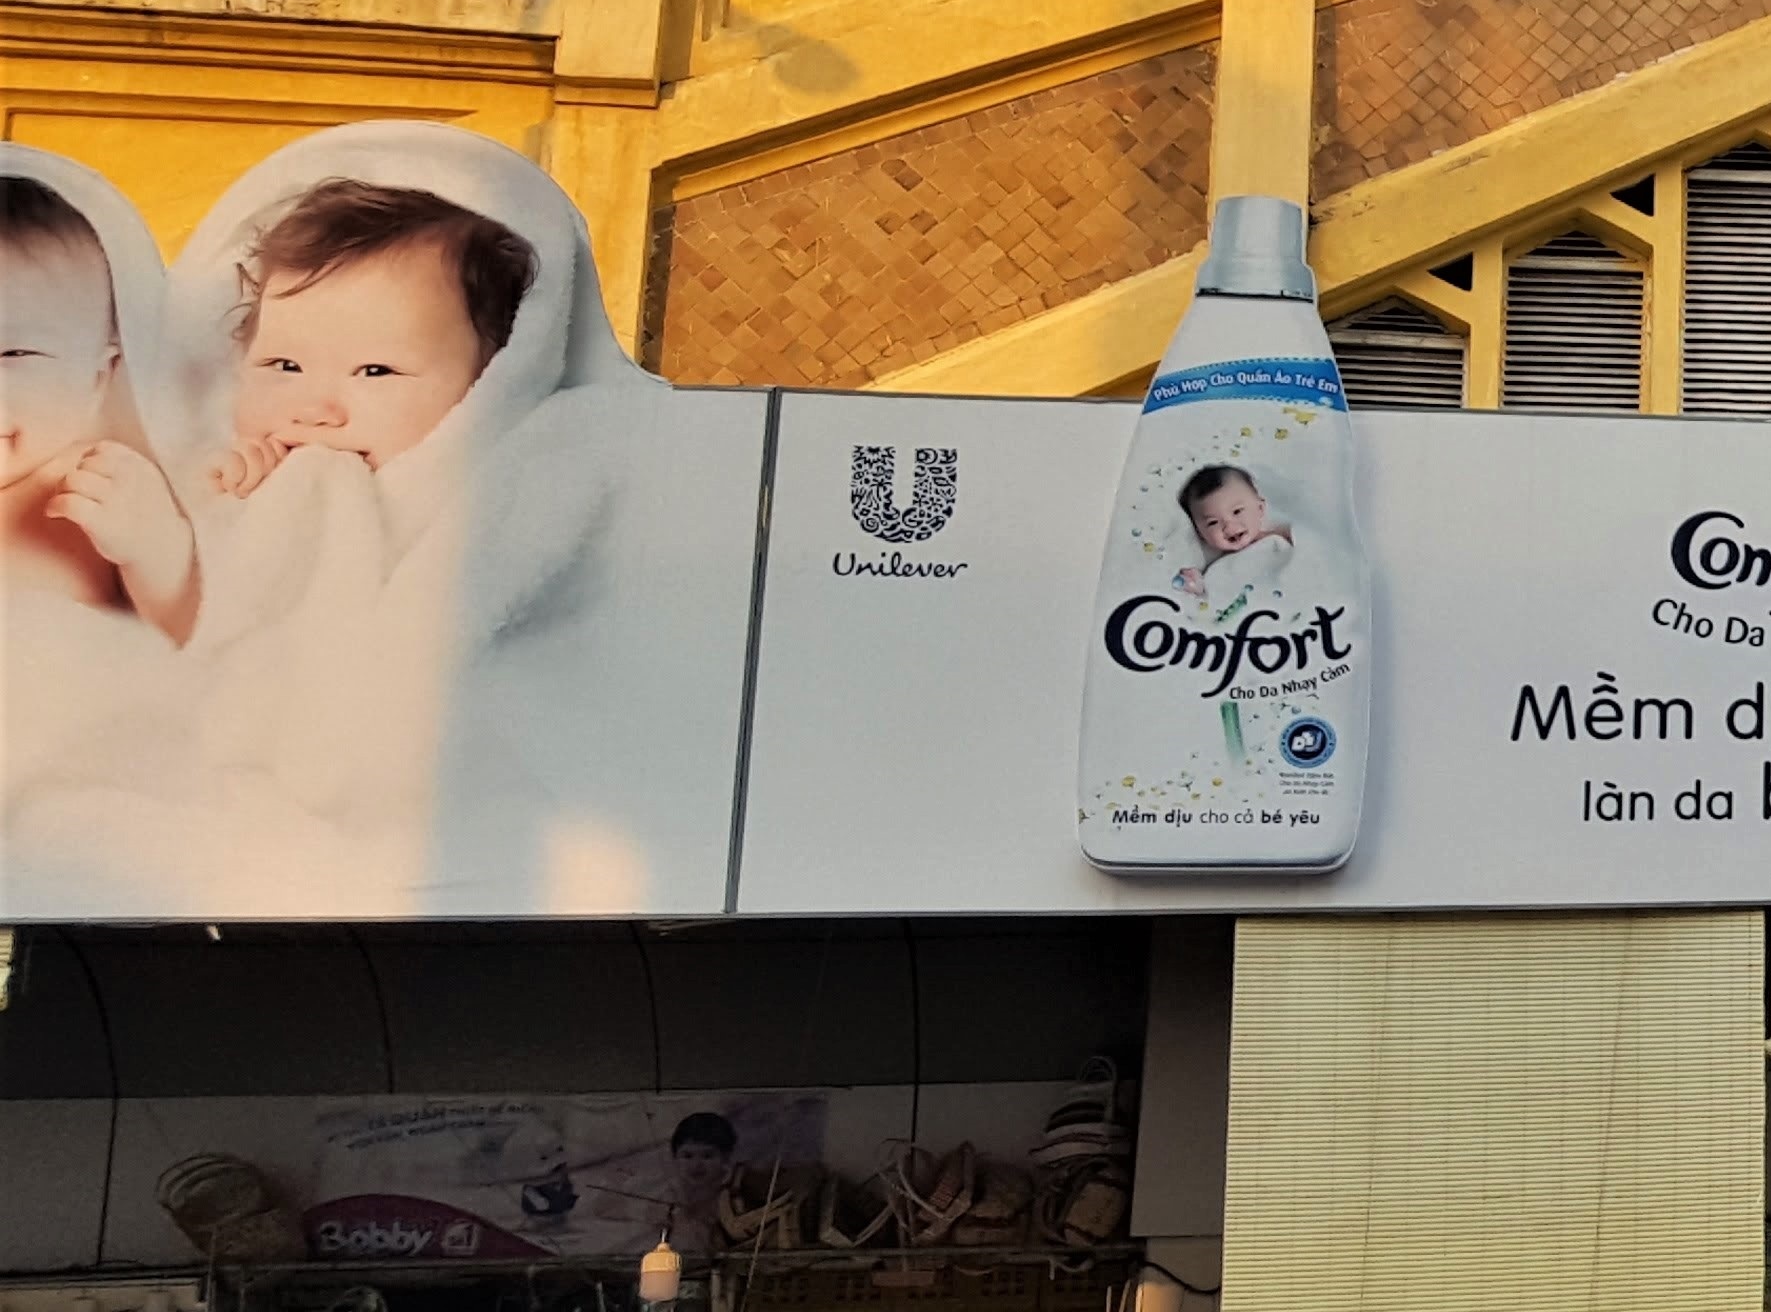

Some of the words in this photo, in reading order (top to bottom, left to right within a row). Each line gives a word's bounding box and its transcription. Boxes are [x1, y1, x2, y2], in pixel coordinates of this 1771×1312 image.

[1210, 372, 1234, 387] Cho
[833, 551, 968, 578] Unilever
[1652, 598, 1714, 638] Cho
[1724, 616, 1764, 647] Da
[1104, 595, 1352, 698] Comfort
[1230, 686, 1255, 699] Cho
[1260, 686, 1278, 698] Da
[1510, 671, 1694, 741] Mềm
[1112, 804, 1157, 824] Mềm
[1164, 808, 1192, 828] dịu
[1200, 808, 1229, 824] cho
[1261, 807, 1283, 824] bé
[1289, 810, 1320, 828] yêu
[1583, 781, 1654, 822] làn
[1674, 780, 1734, 821] da
[319, 1219, 433, 1256] Bobby
